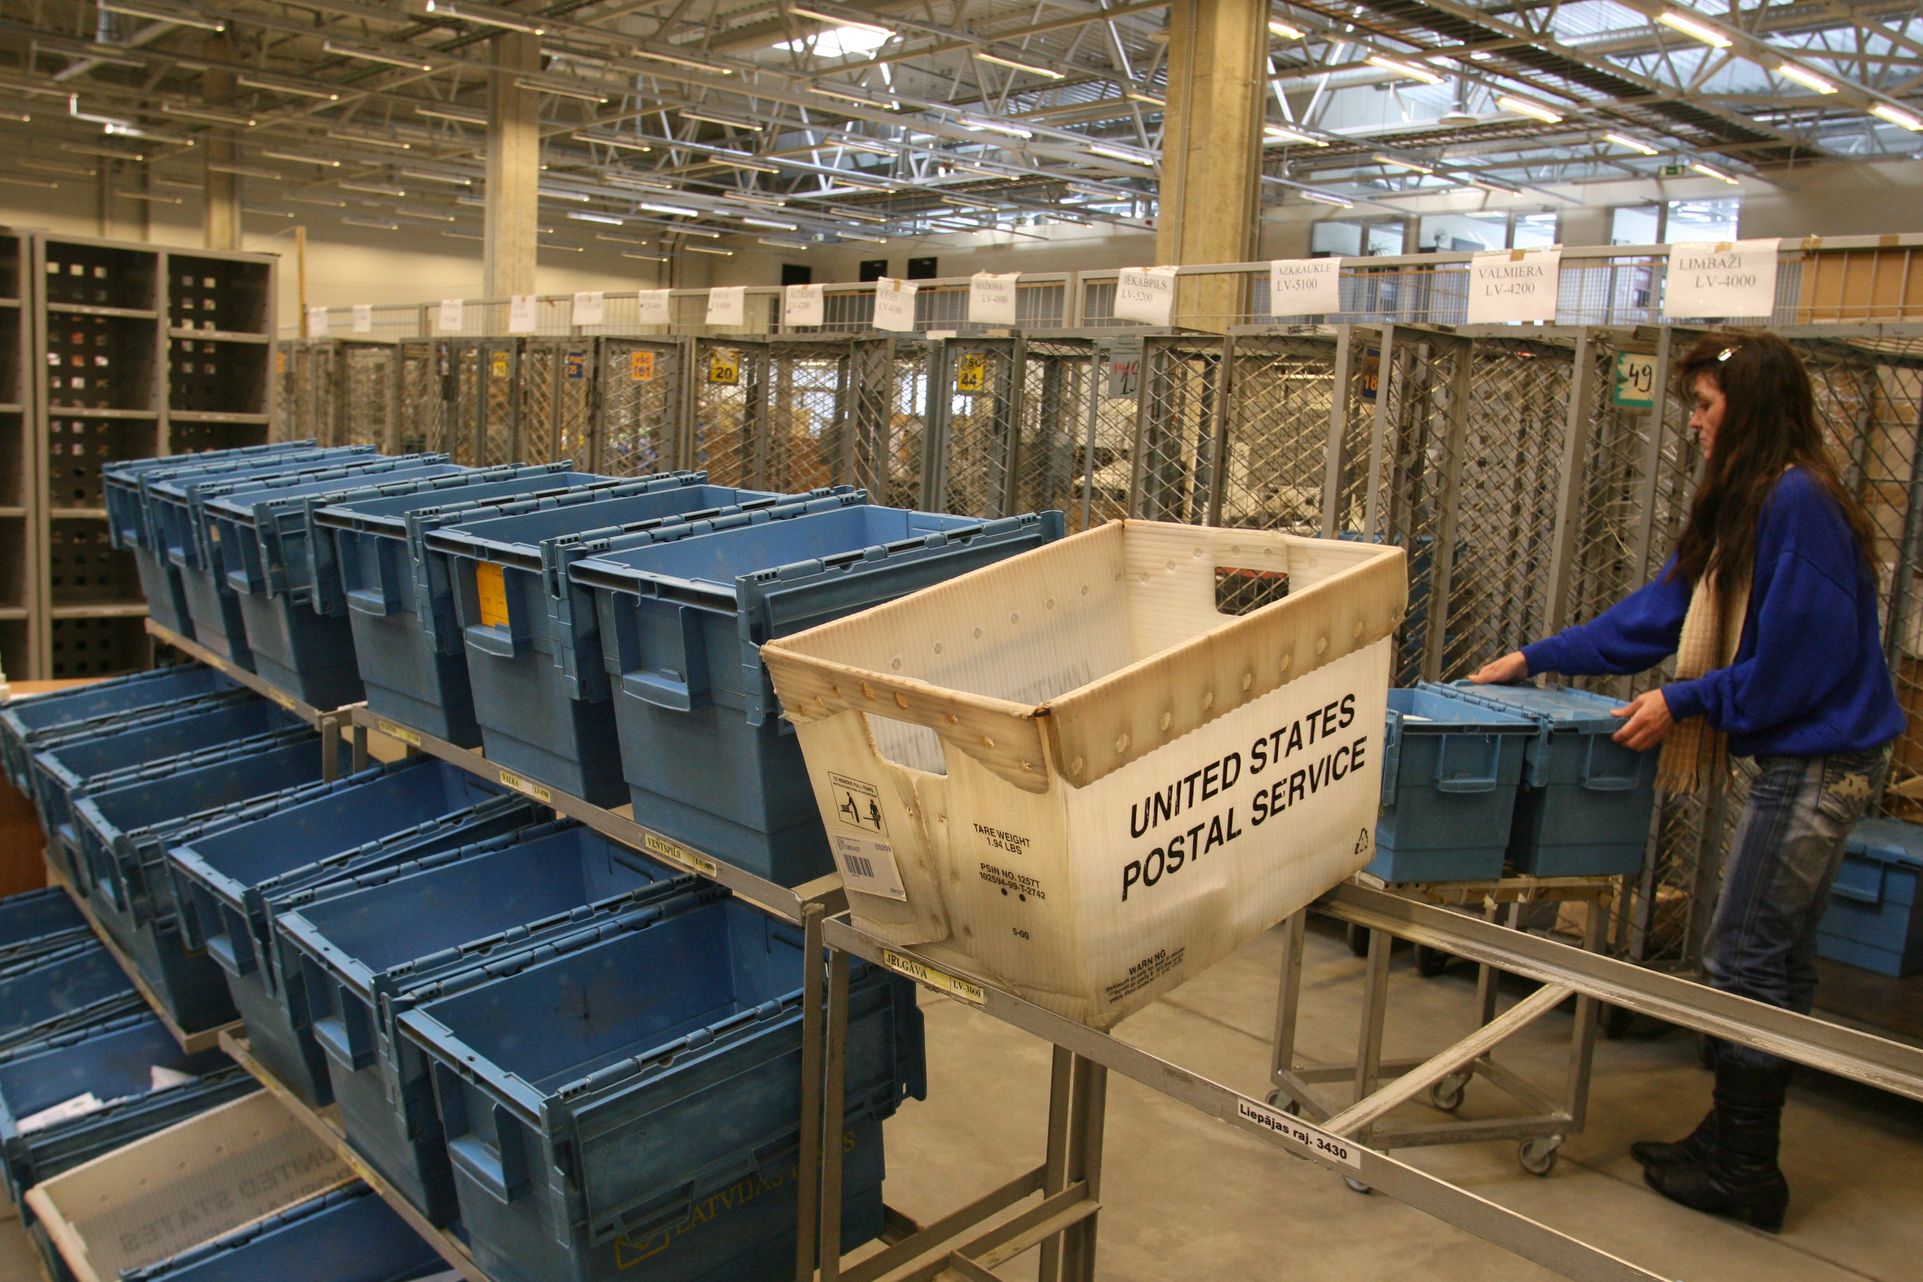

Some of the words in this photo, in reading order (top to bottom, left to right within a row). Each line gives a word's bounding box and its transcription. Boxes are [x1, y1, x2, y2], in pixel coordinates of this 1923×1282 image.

[1678, 254, 1742, 270] LIMBAŽI
[1479, 265, 1543, 279] VALMIERA
[1277, 278, 1318, 292] LV-5100
[1485, 282, 1535, 296] LV-4200
[1694, 274, 1756, 288] LV-4000
[715, 366, 733, 379] 20
[961, 373, 977, 387] 44
[1629, 363, 1652, 392] 49
[1130, 751, 1241, 839] UNITED
[1249, 693, 1356, 775] STATES
[1121, 807, 1242, 902] POSTAL
[1251, 736, 1368, 826] SERVICE
[973, 823, 996, 838] TARE
[996, 829, 1030, 848] WEIGHT
[986, 837, 1003, 850] 1.94
[1005, 842, 1023, 856] LBS
[980, 862, 1000, 876] PSIN
[1001, 868, 1017, 881] NO.
[1239, 1103, 1290, 1134] Liepājas
[1293, 1129, 1313, 1145] raj.
[1316, 1138, 1347, 1160] 3430
